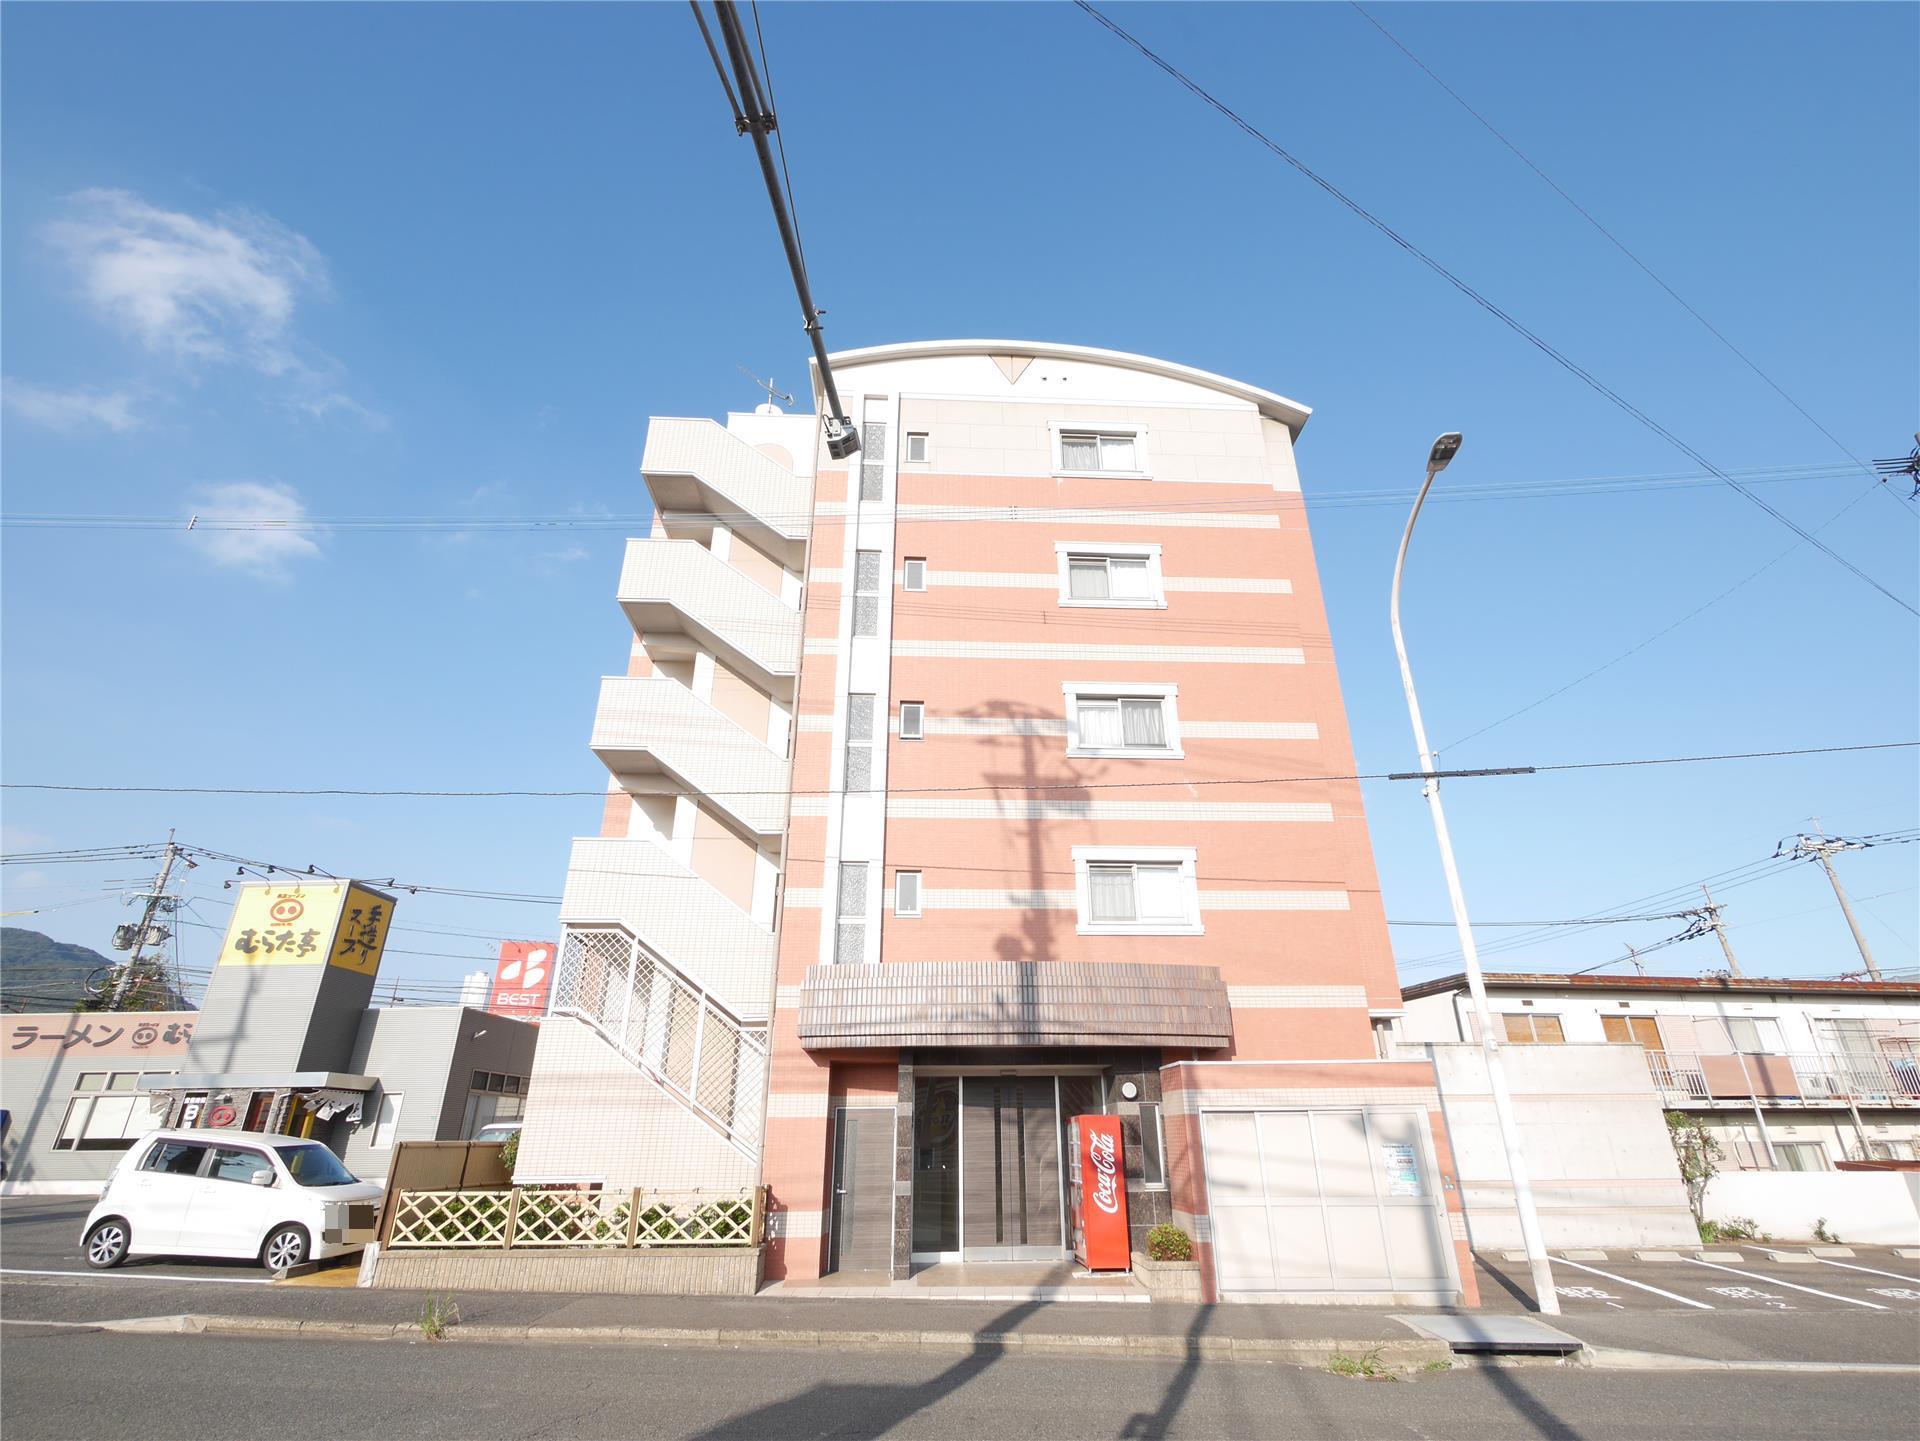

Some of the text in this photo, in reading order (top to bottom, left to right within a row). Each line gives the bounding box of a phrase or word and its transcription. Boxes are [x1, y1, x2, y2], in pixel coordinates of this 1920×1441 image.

[235, 928, 320, 958] むらた亭
[496, 992, 541, 1006] BEST
[12, 1023, 125, 1049] ラーメン
[1089, 1128, 1119, 1214] Coca-Cola
